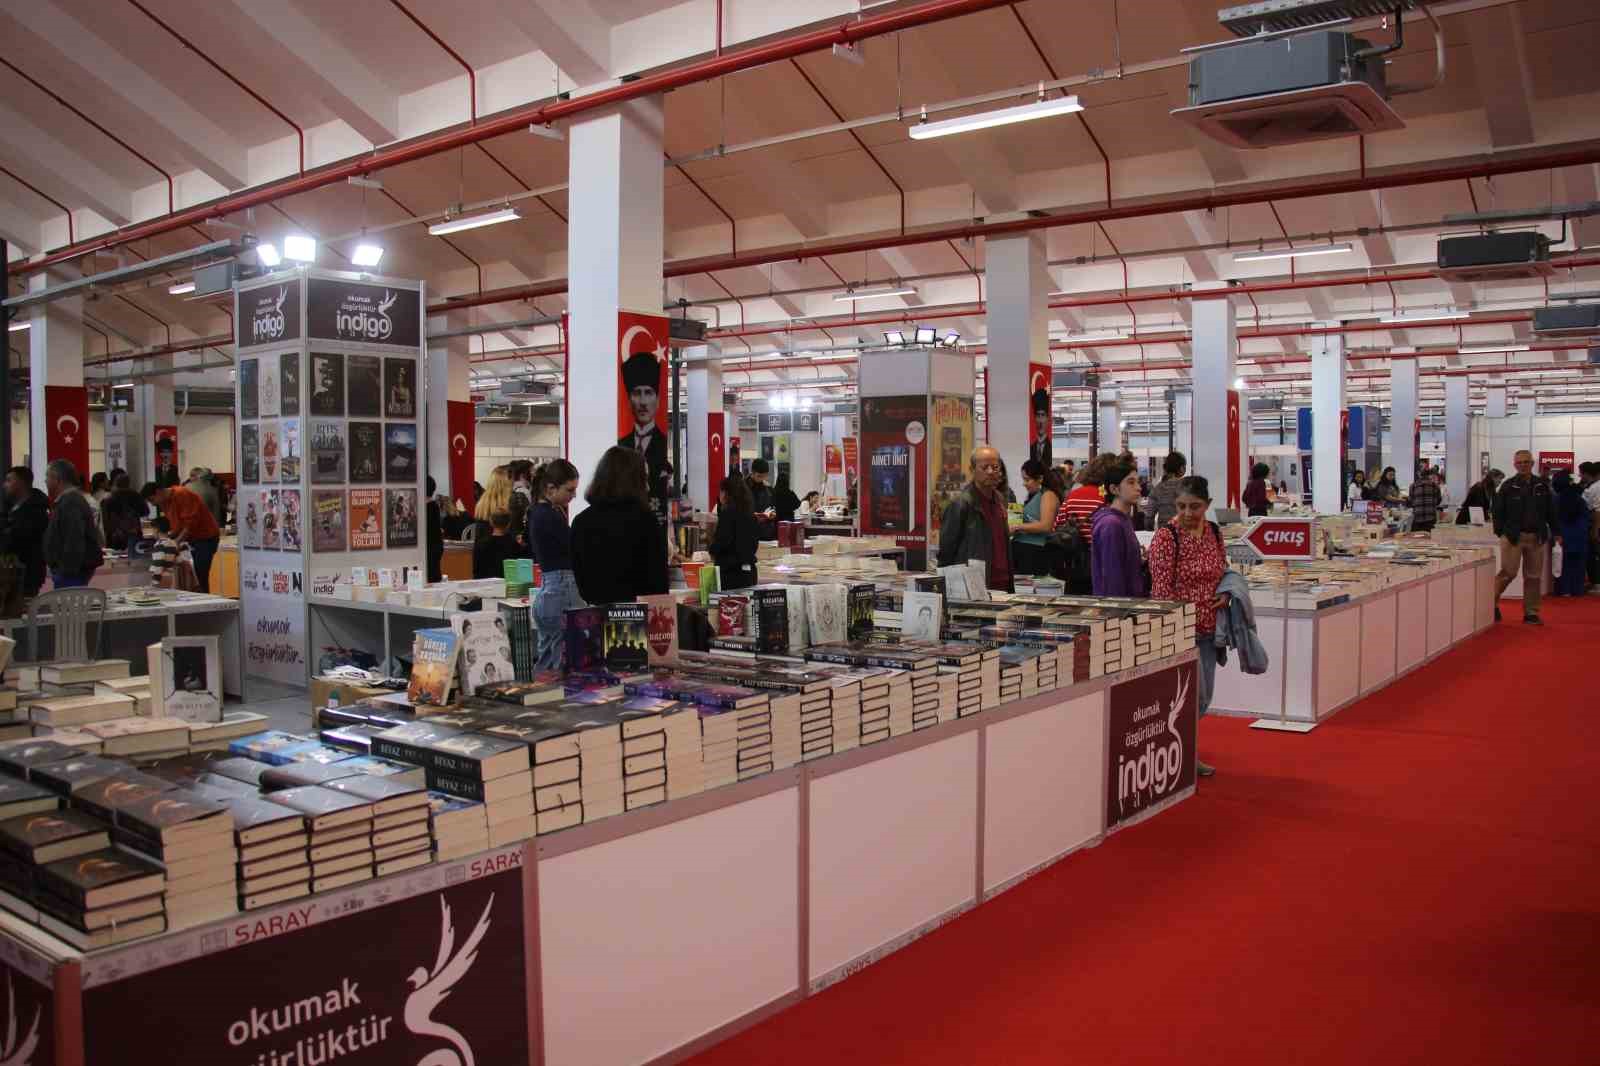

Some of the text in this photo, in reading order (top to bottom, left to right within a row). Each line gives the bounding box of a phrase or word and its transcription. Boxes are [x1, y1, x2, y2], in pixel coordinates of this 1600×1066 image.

[252, 315, 285, 337] indigo
[336, 310, 391, 338] indigo
[871, 455, 890, 466] AHMET
[1263, 530, 1305, 547] ÇIKIŞ
[313, 582, 335, 595] indig
[1133, 701, 1161, 722] okumak
[1125, 720, 1166, 747] özgürlüktür
[1118, 740, 1181, 799] indigo
[470, 849, 523, 878] SARA
[235, 906, 313, 943] SARAY
[227, 977, 361, 1046] okumak
[247, 1015, 393, 1066] ürlüktür
